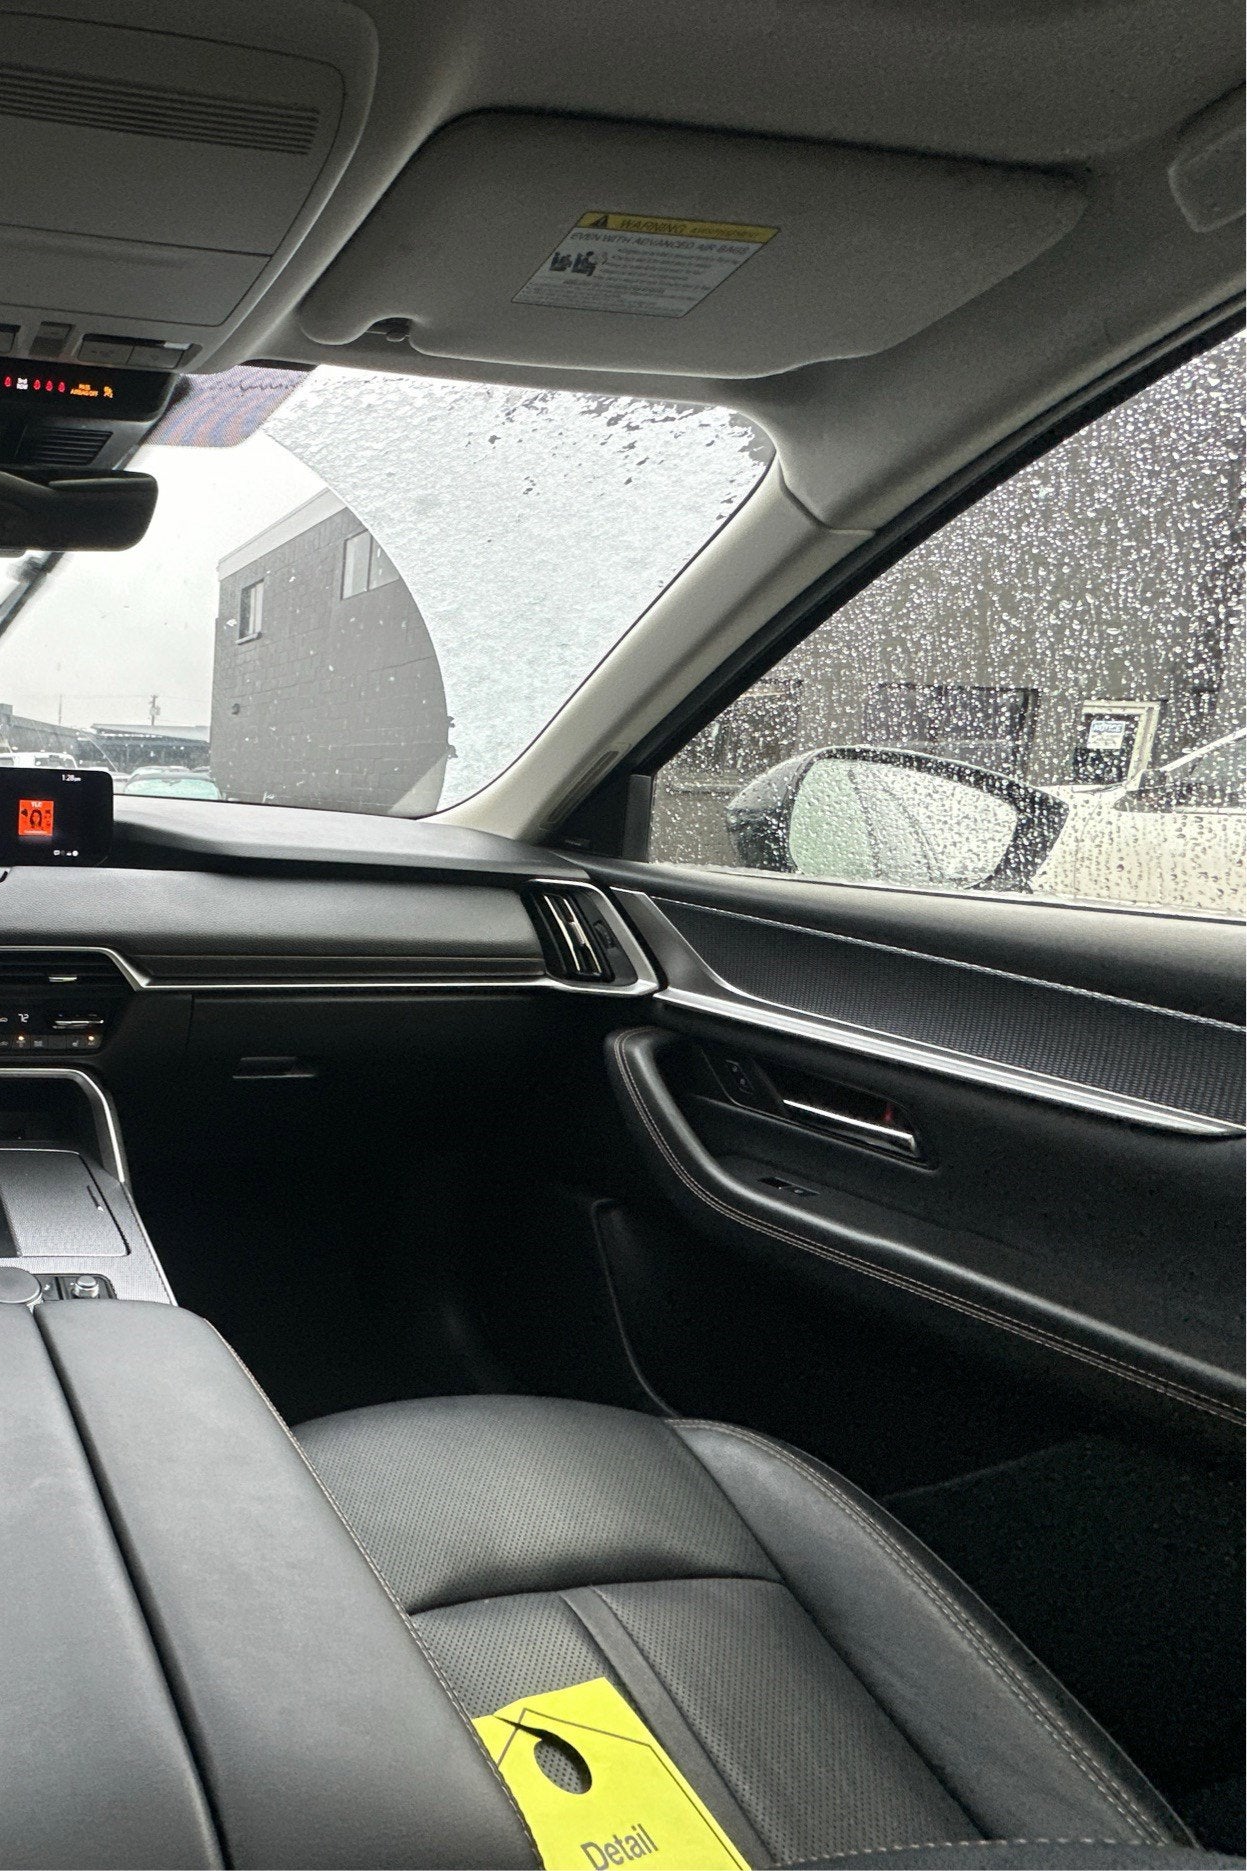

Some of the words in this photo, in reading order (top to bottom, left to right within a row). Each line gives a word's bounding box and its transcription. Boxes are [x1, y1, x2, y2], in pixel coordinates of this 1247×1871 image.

[620, 219, 688, 234] WARNING
[570, 232, 601, 241] EVEN
[603, 235, 633, 243] WITH
[634, 237, 696, 249] ADVANCED
[18, 1013, 29, 1023] 72
[580, 1823, 659, 1871] Detail
